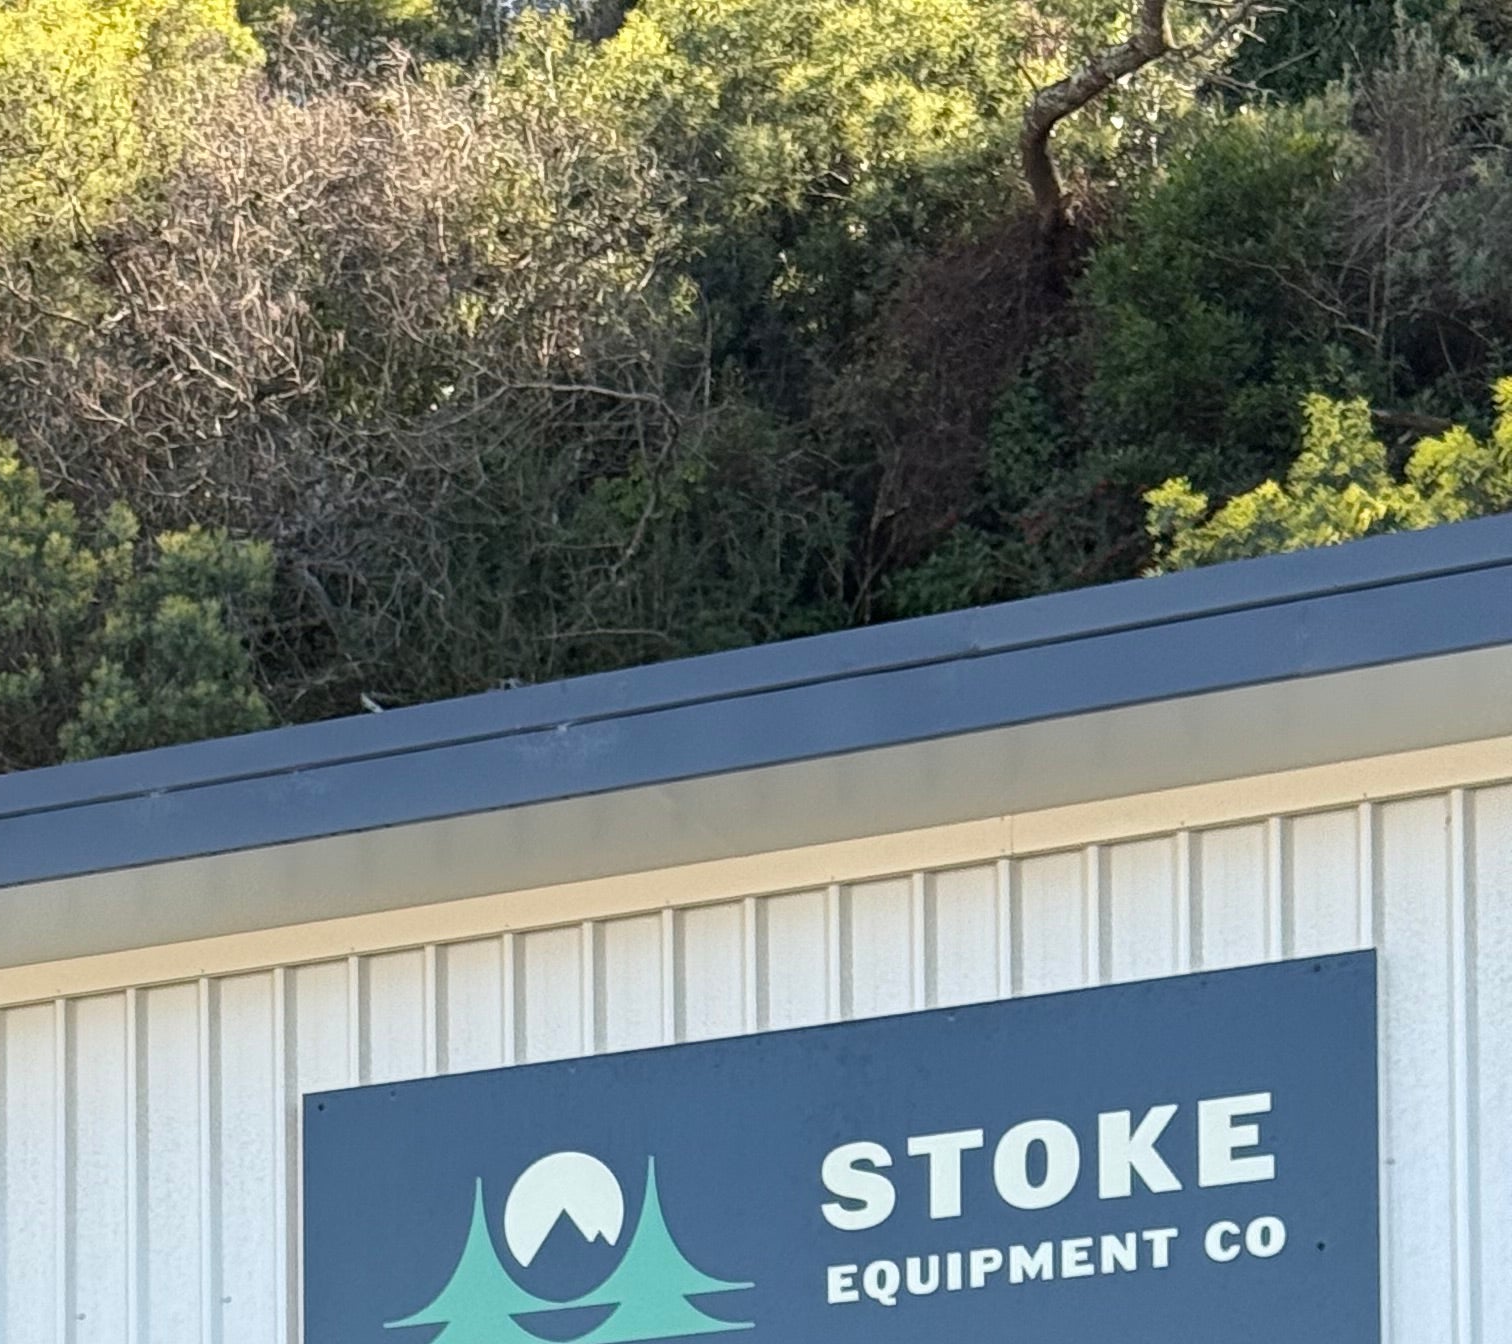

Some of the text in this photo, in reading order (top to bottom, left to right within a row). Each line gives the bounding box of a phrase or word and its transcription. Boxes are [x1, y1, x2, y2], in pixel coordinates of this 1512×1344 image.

[820, 1091, 1276, 1232] STOKE
[826, 1216, 1287, 1306] EQUIPMENT CO
